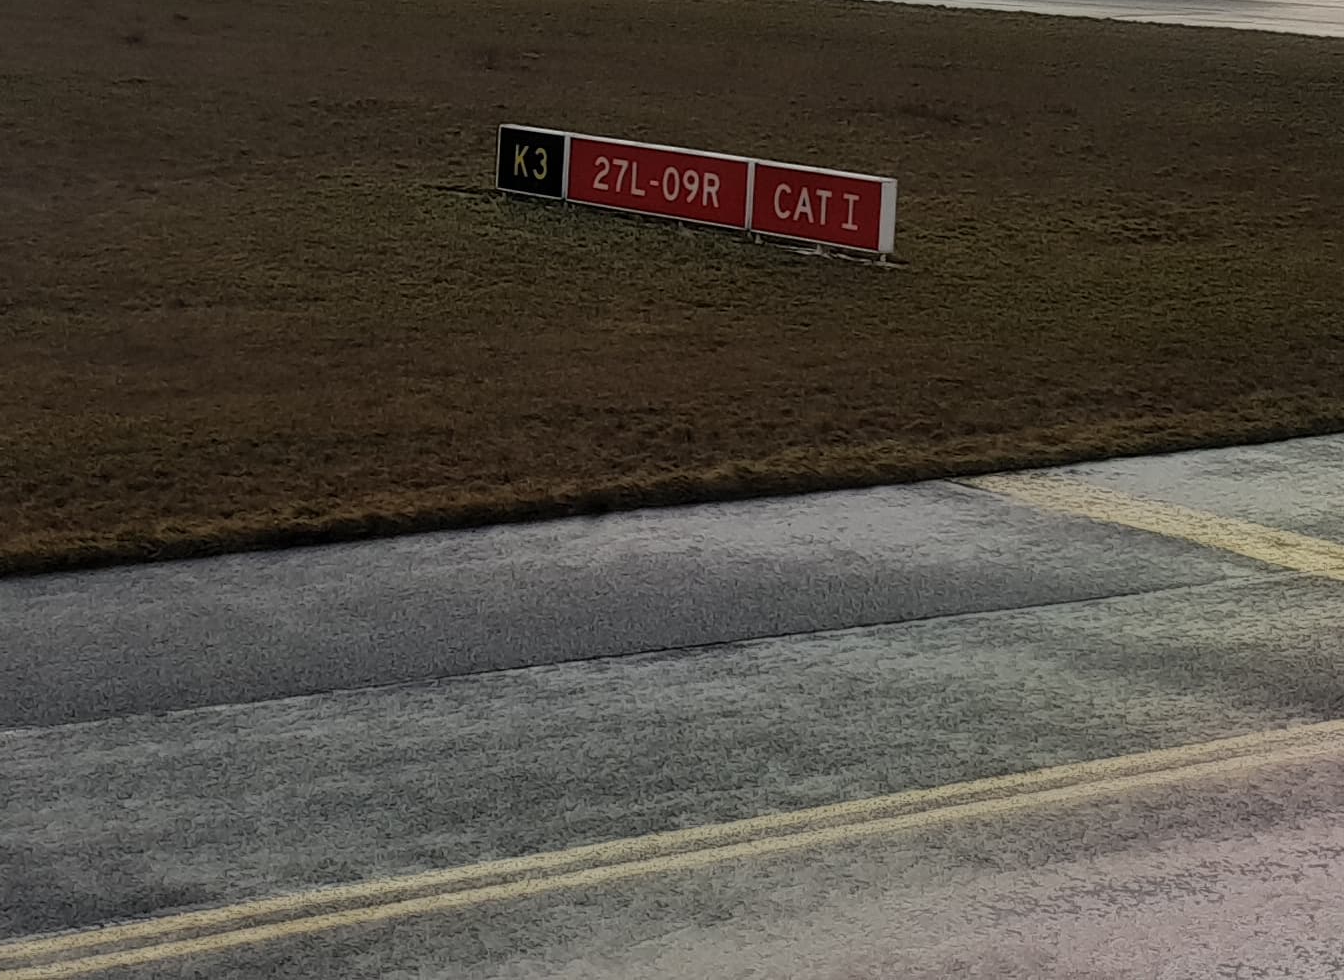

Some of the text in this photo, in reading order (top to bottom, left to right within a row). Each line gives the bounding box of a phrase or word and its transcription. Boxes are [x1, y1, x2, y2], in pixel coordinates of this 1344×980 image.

[513, 144, 548, 180] K3
[592, 156, 721, 208] 27L-09R
[773, 183, 860, 231] CAT I
